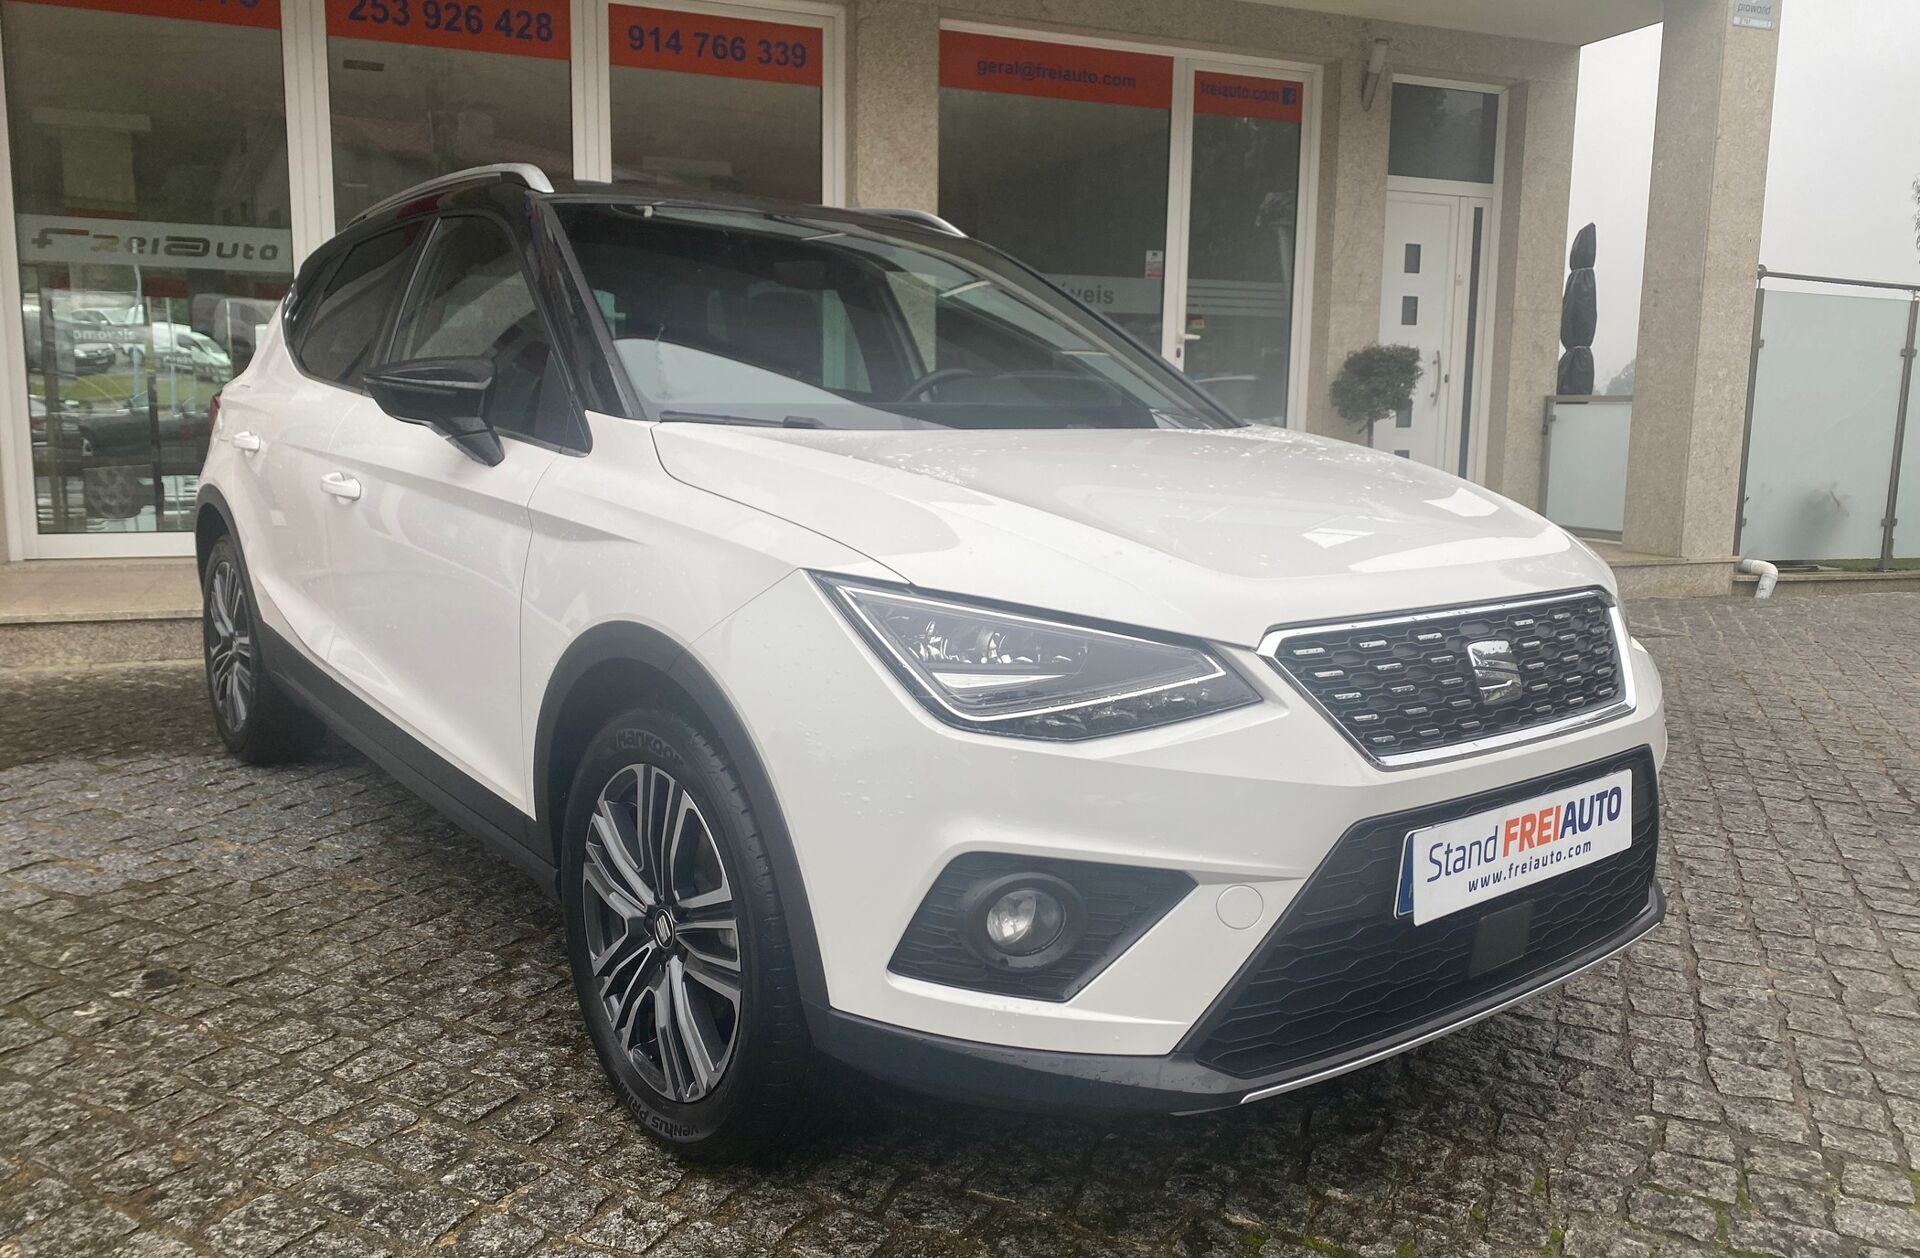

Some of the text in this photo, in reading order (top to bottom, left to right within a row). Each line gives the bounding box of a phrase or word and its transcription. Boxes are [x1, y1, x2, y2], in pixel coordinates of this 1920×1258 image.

[348, 0, 553, 43] 253 926 428
[628, 25, 808, 69] 914 766 339
[976, 58, 1137, 89] geral@freiauto.com
[1200, 78, 1280, 102] freiauto.com
[1427, 785, 1623, 883] Stand FREIAUTO
[1467, 840, 1592, 893] www.freiauto.com
